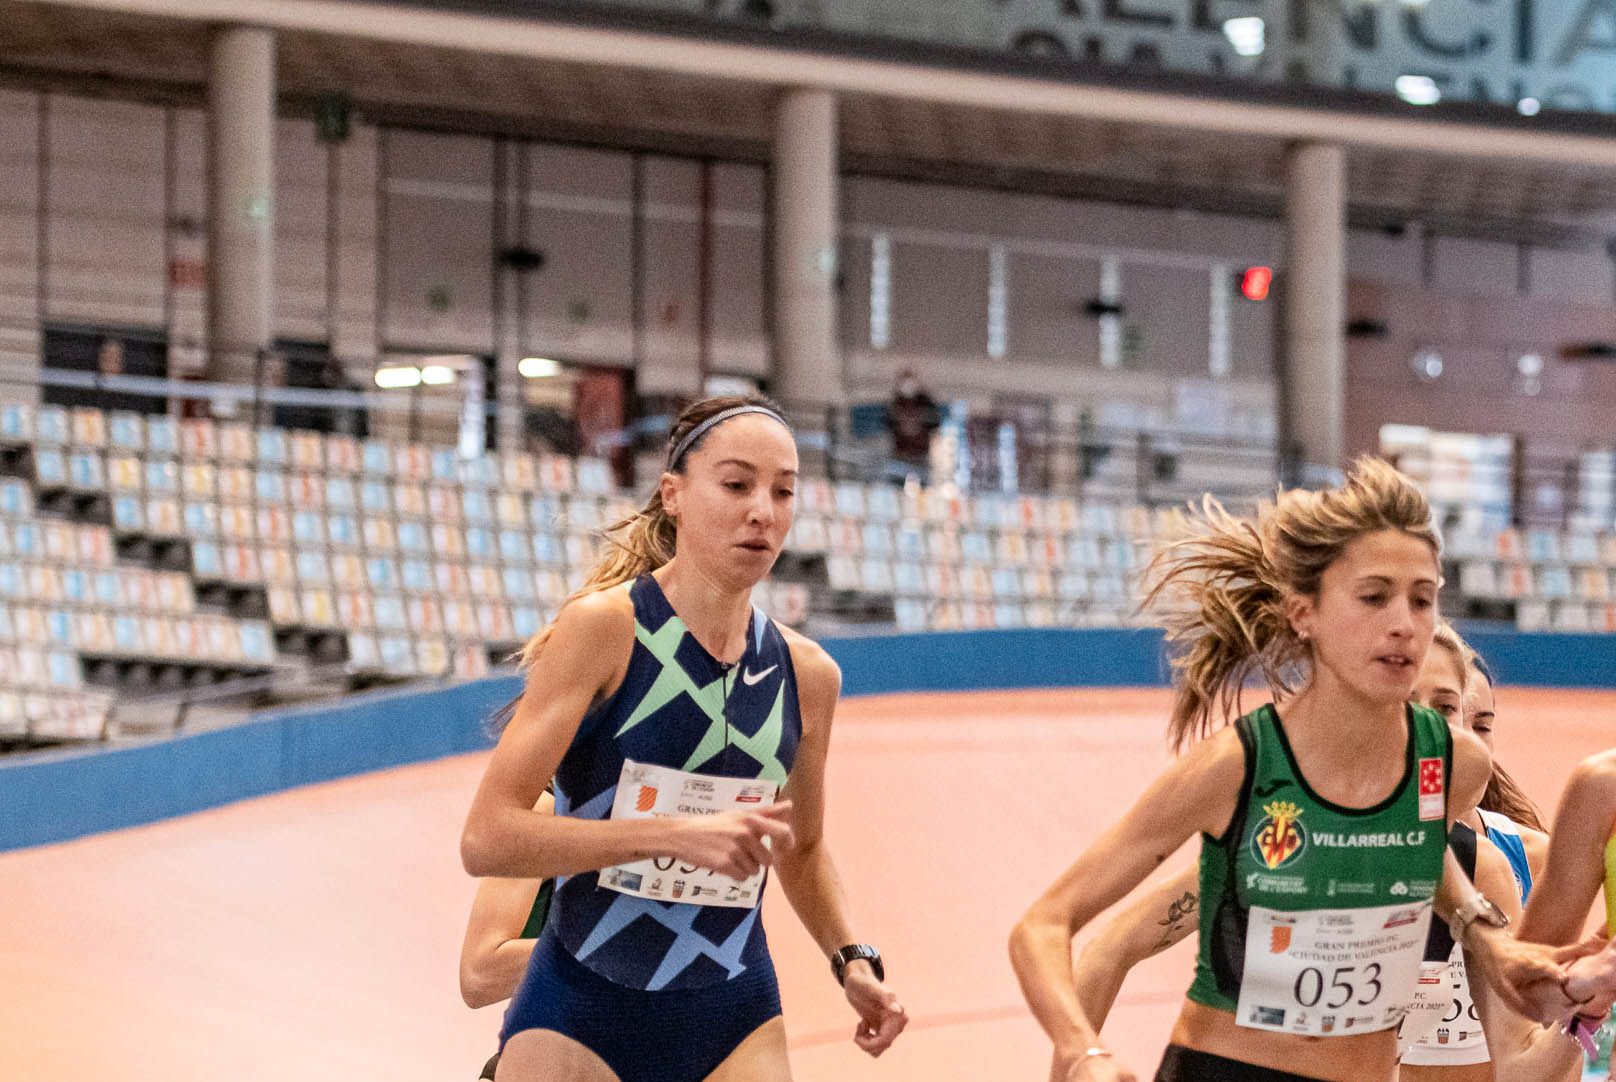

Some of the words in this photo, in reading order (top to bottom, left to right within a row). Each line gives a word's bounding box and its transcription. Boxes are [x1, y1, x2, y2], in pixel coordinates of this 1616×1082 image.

[677, 804, 705, 815] GRAN
[1312, 832, 1404, 847] VILLARREAL
[1314, 941, 1345, 951] GRAN
[1337, 953, 1351, 961] DE
[1294, 962, 1382, 1009] 053
